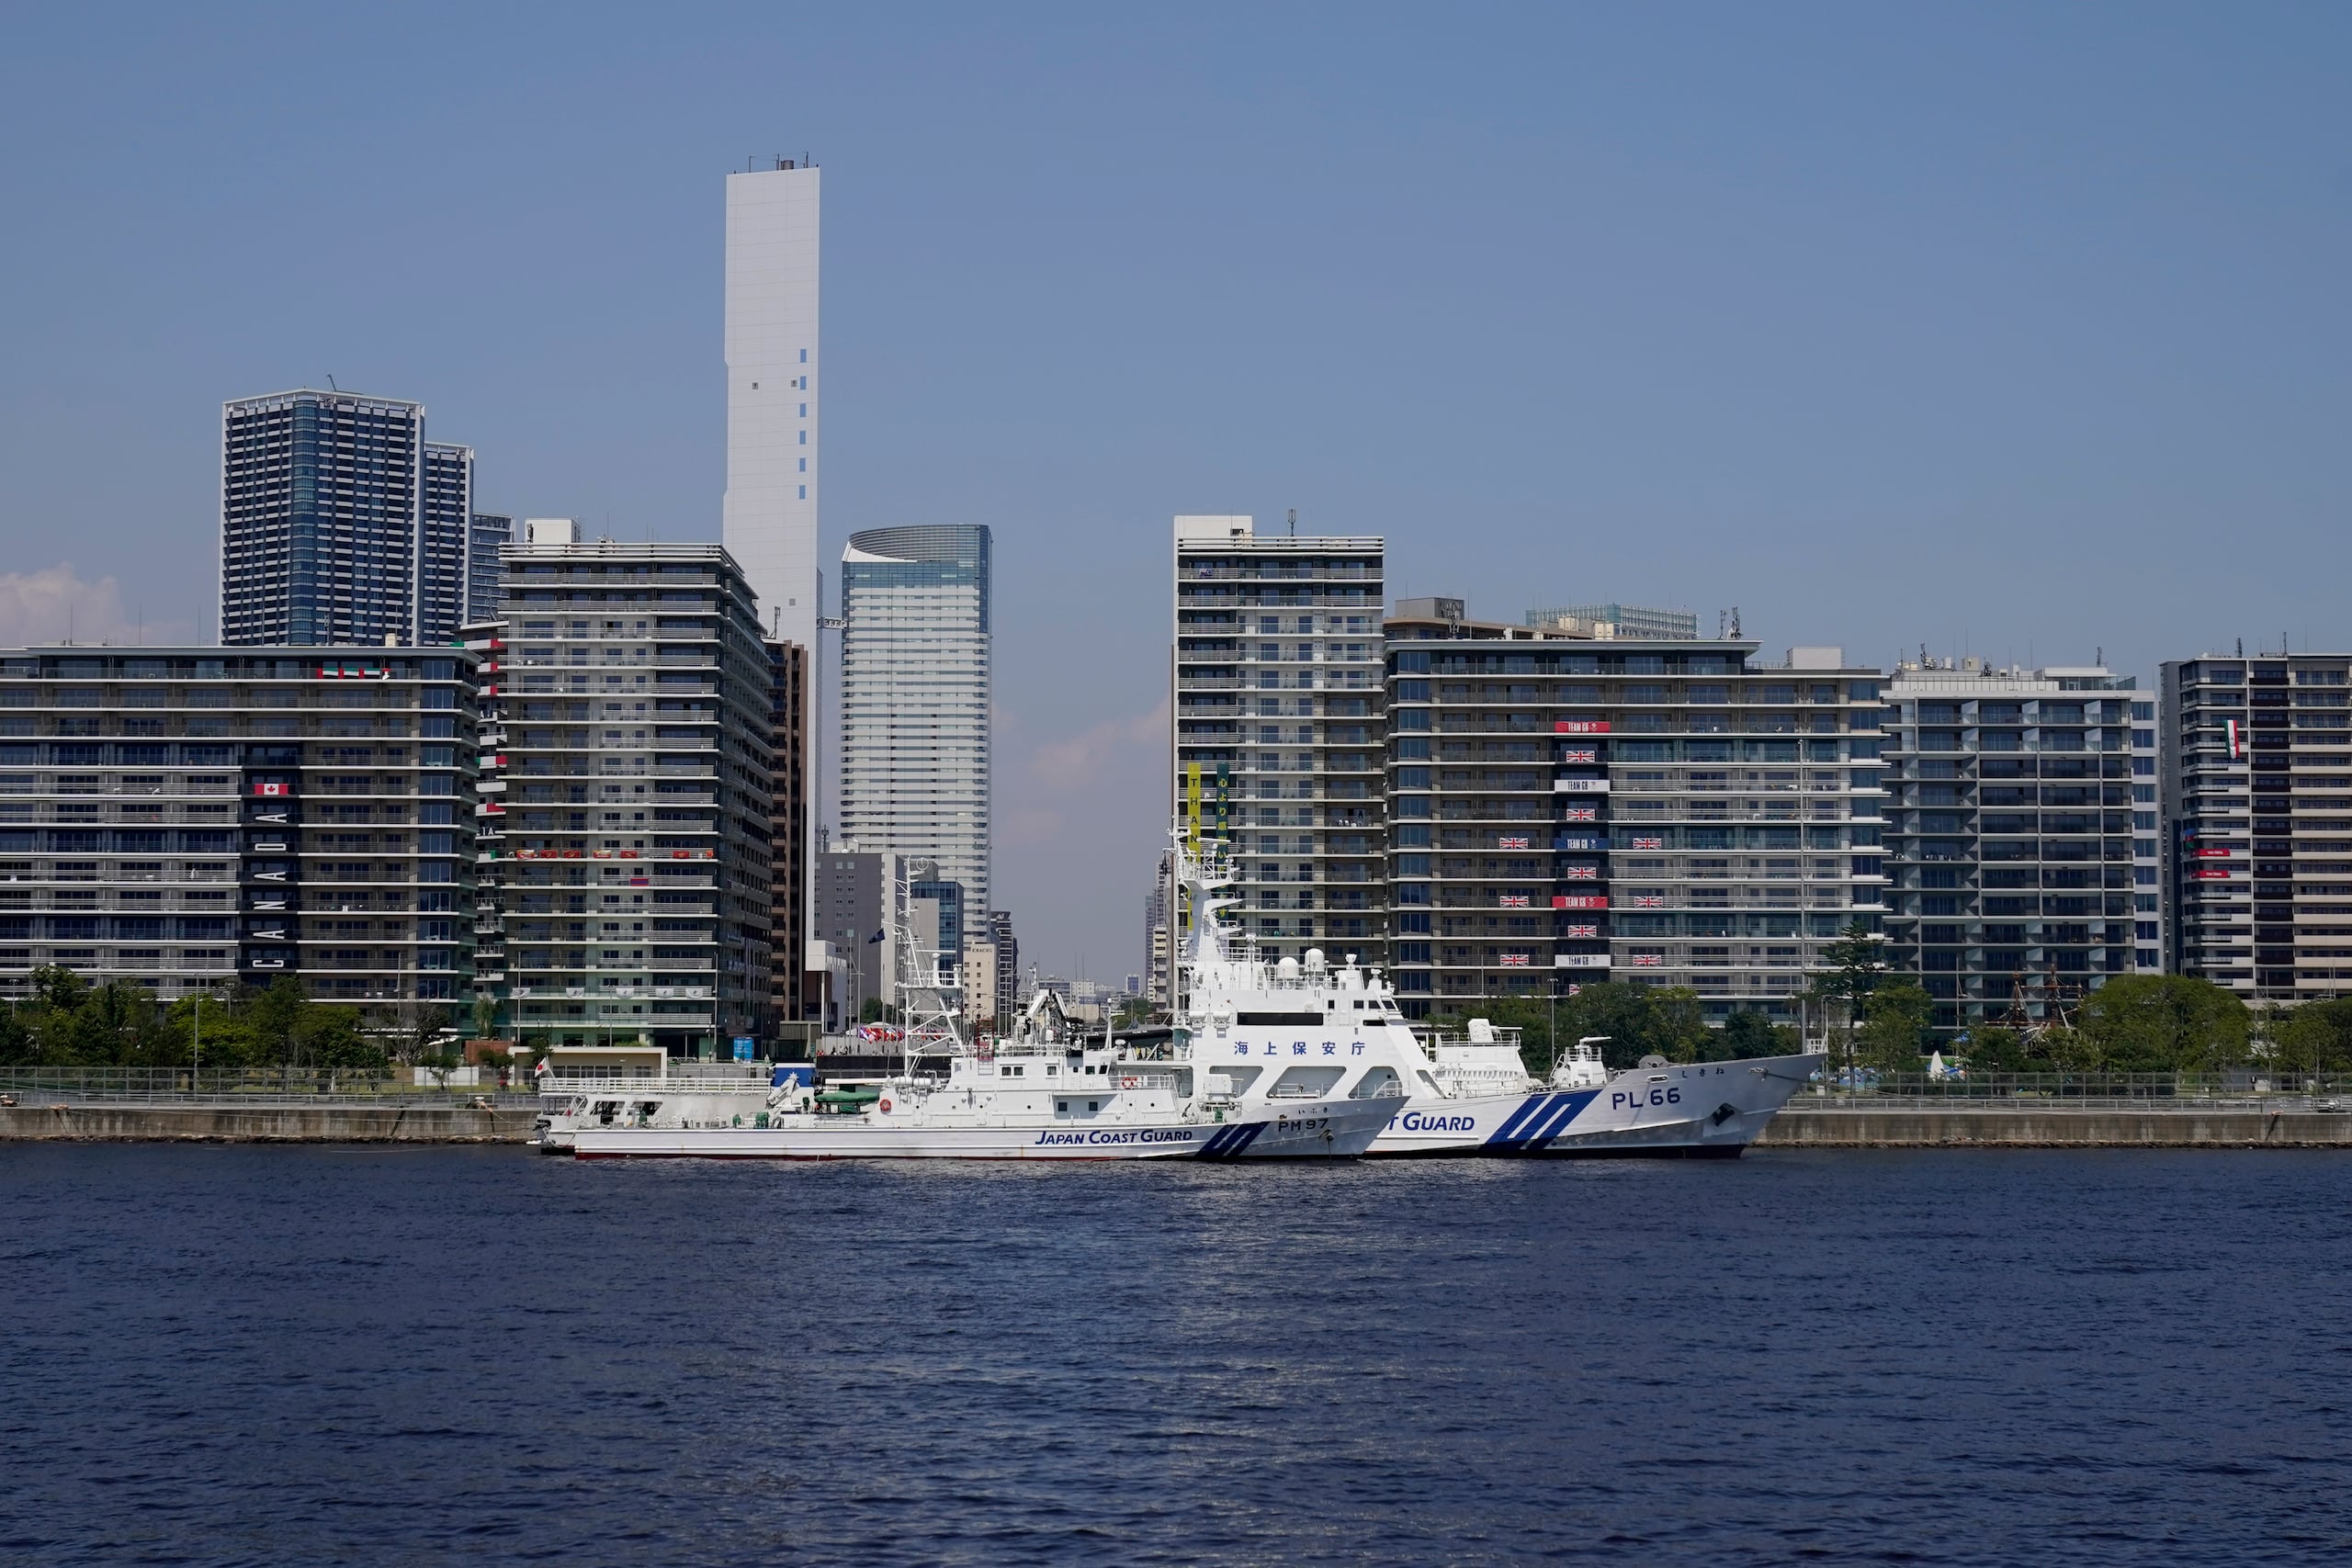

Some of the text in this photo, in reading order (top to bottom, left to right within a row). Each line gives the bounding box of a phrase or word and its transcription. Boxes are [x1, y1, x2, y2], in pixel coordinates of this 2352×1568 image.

[1568, 722, 1581, 732] TEAM
[1567, 781, 1589, 790] TEAM GB
[1566, 839, 1589, 849] TEAM GB
[252, 813, 288, 968] CANADA
[1565, 897, 1587, 908] TEAM GB
[1567, 956, 1581, 965] TEAM
[1234, 1041, 1366, 1055] 海上保安庁
[1611, 1088, 1681, 1111] PL 66
[1278, 1118, 1329, 1132] PM 97
[1402, 1111, 1475, 1131] GUARD
[1035, 1129, 1193, 1145] JAPAN COAST GUARD
